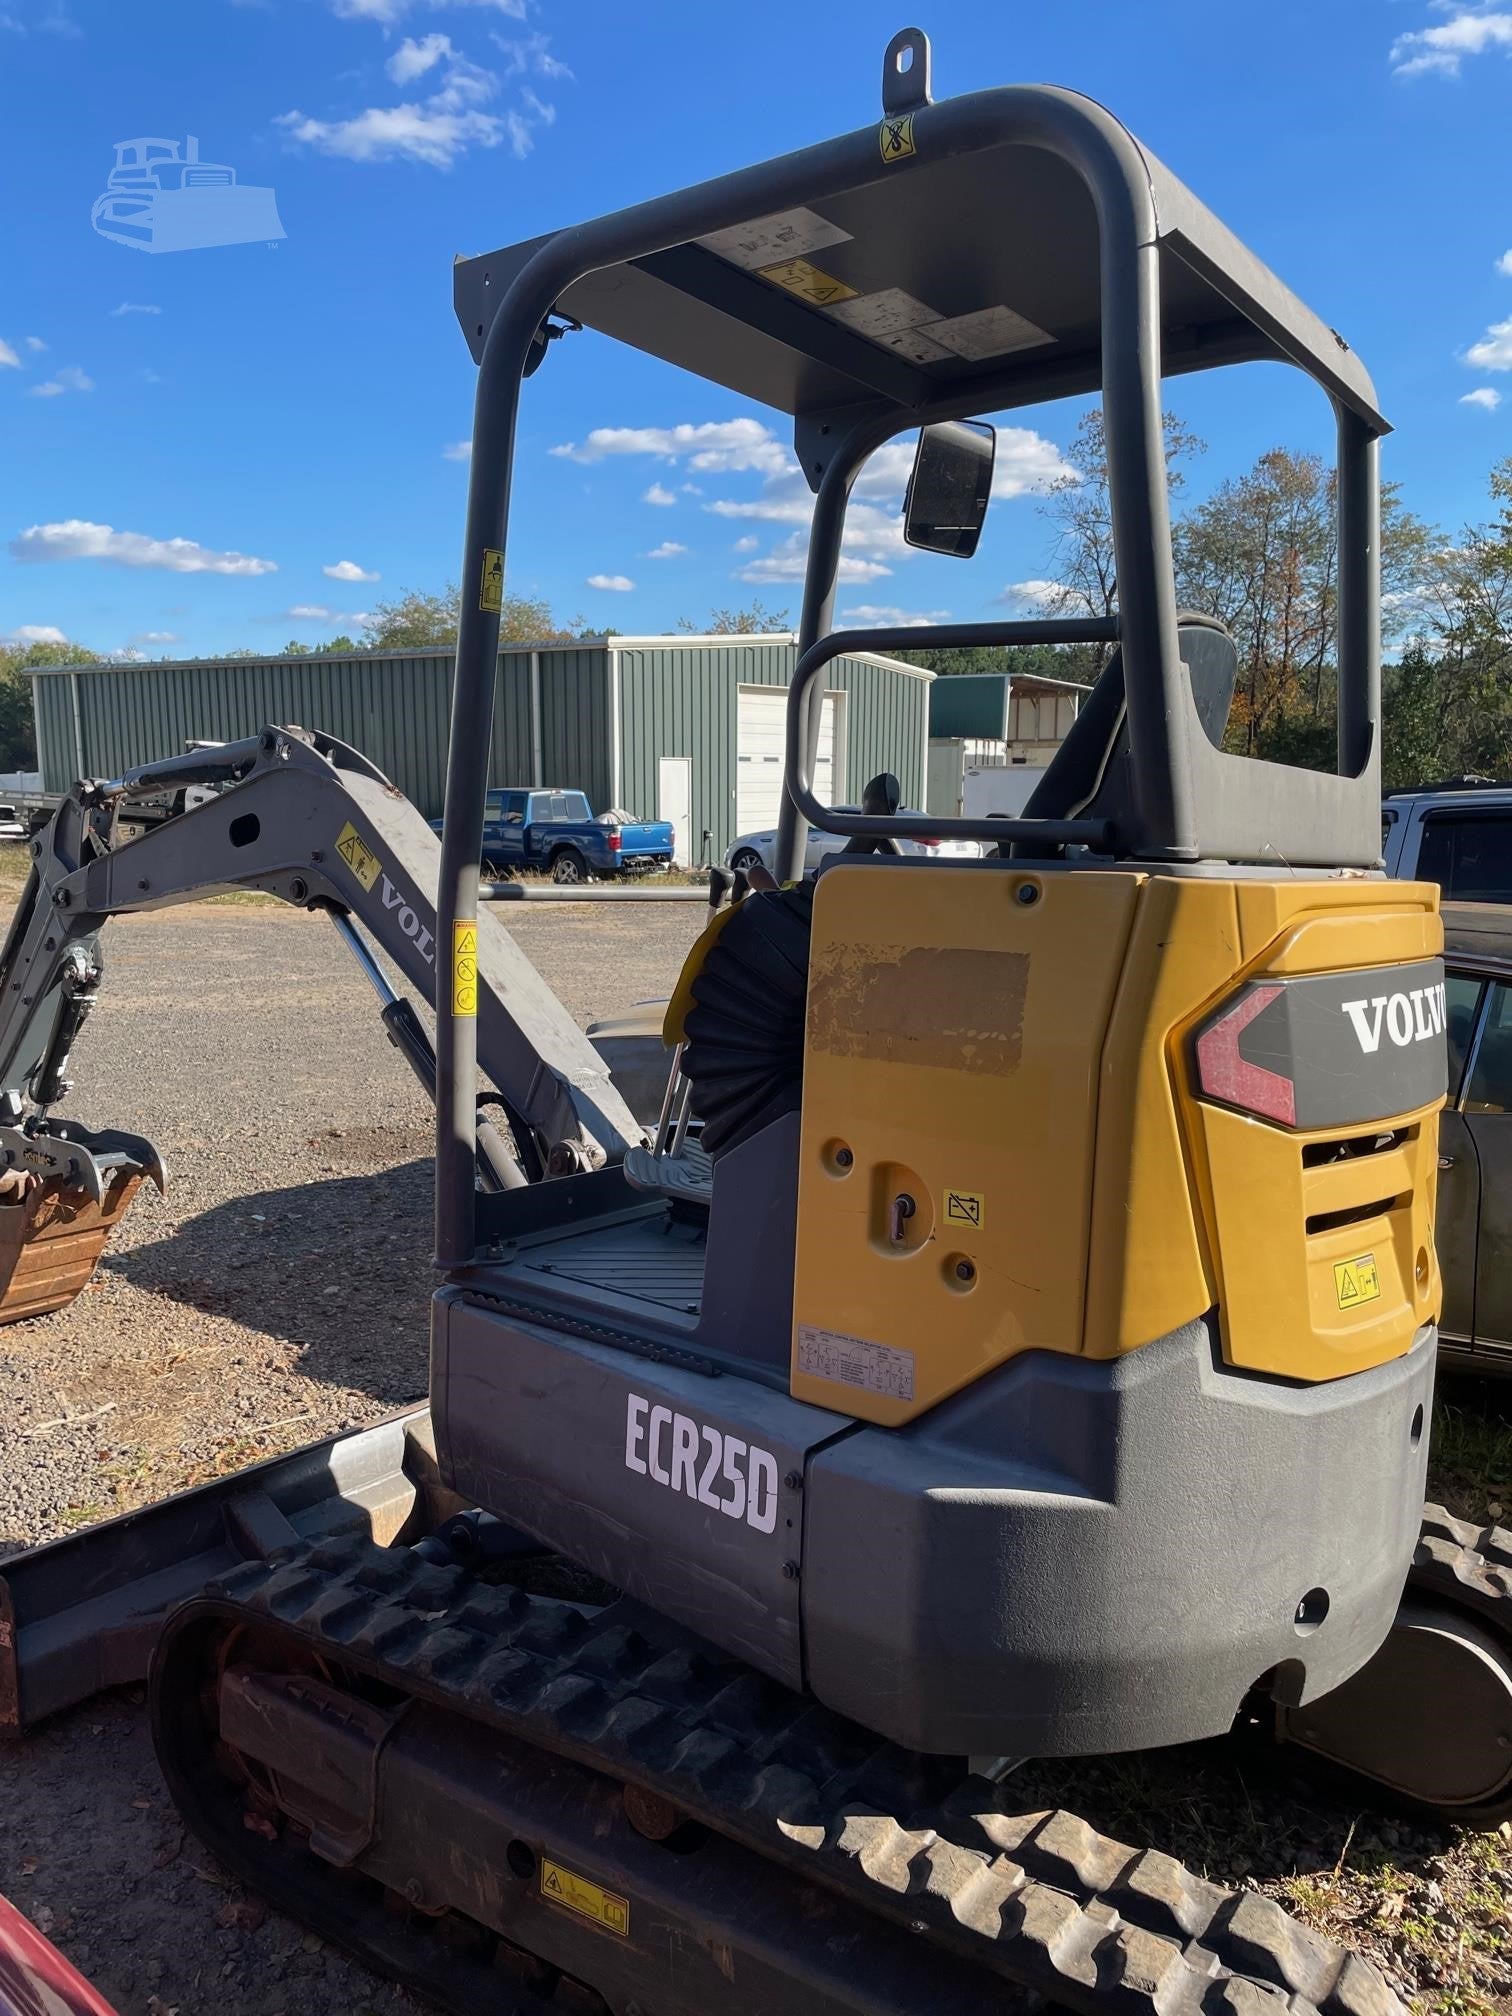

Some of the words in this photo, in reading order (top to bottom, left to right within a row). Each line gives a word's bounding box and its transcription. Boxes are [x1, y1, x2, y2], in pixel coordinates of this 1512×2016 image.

[382, 872, 438, 974] VOL
[1341, 982, 1447, 1053] VOLVO
[625, 1392, 778, 1535] ECR25D
